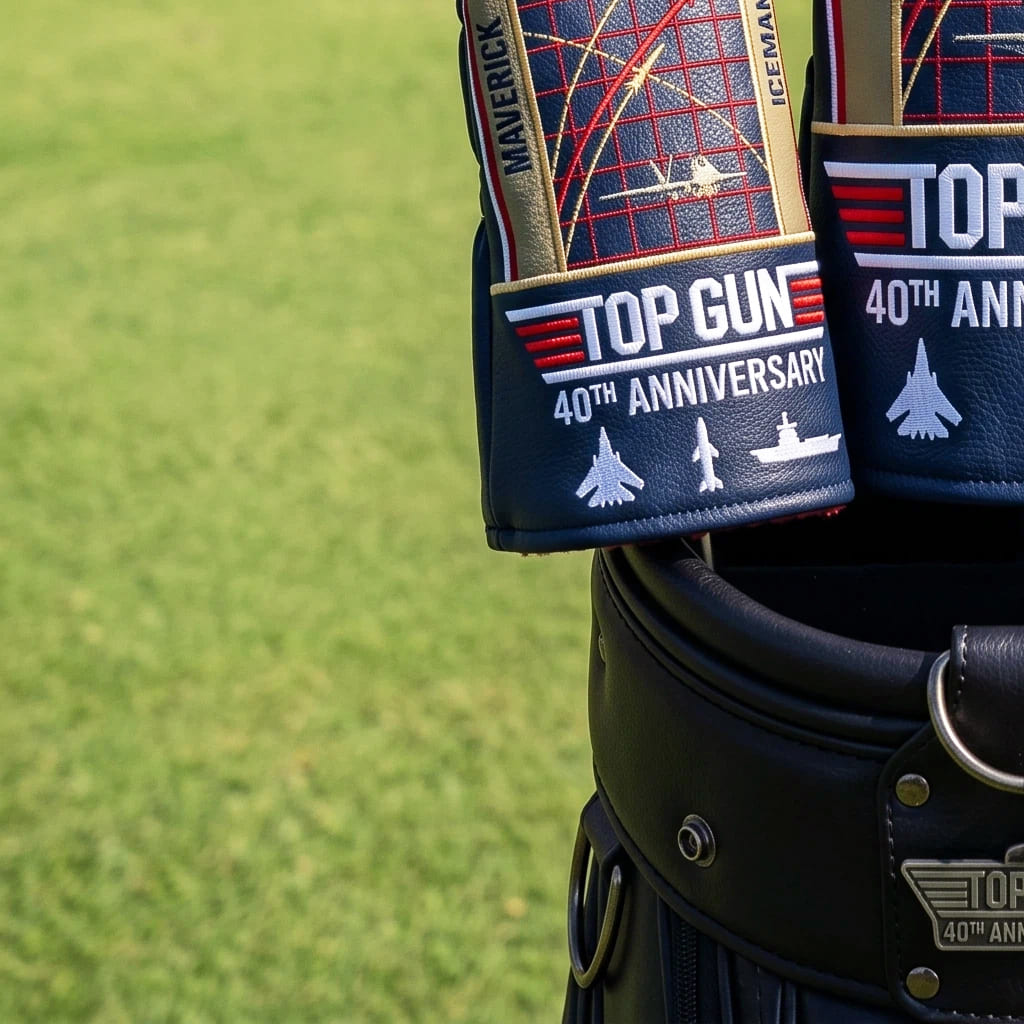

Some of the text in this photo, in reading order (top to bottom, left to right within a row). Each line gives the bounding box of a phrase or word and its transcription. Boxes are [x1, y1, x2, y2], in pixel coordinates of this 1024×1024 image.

[475, 15, 533, 176] MAVERICK
[575, 269, 795, 361] TOP GUN
[865, 278, 940, 326] 40TH
[553, 346, 827, 426] 40TH ANNIVERSARY
[943, 921, 985, 943] 40TH
